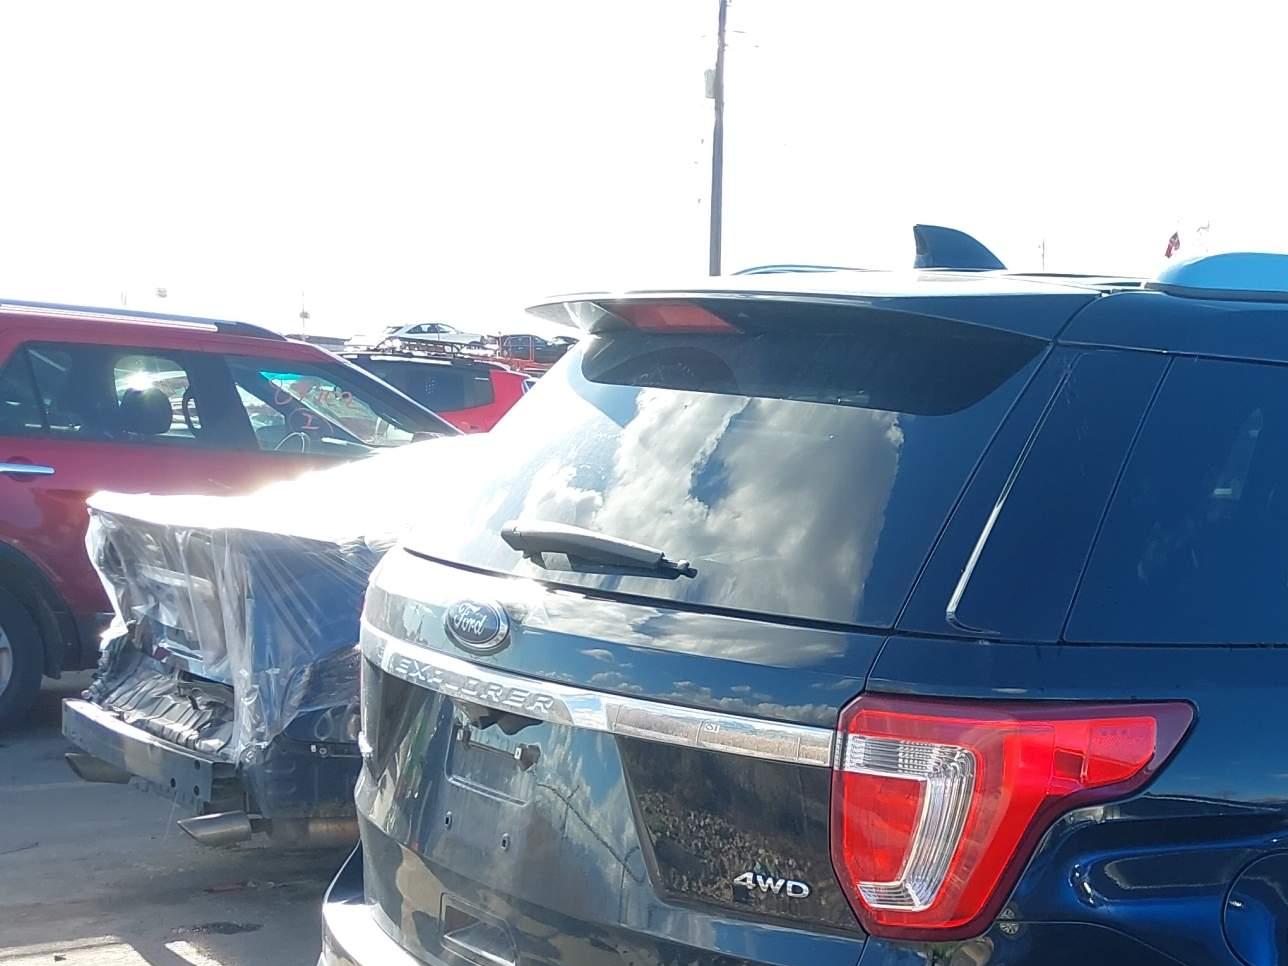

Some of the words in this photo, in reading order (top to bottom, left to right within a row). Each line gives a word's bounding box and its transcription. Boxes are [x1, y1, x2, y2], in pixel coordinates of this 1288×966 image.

[453, 602, 488, 636] Ford
[395, 658, 554, 713] EXPLORER
[733, 871, 810, 899] 4WD
